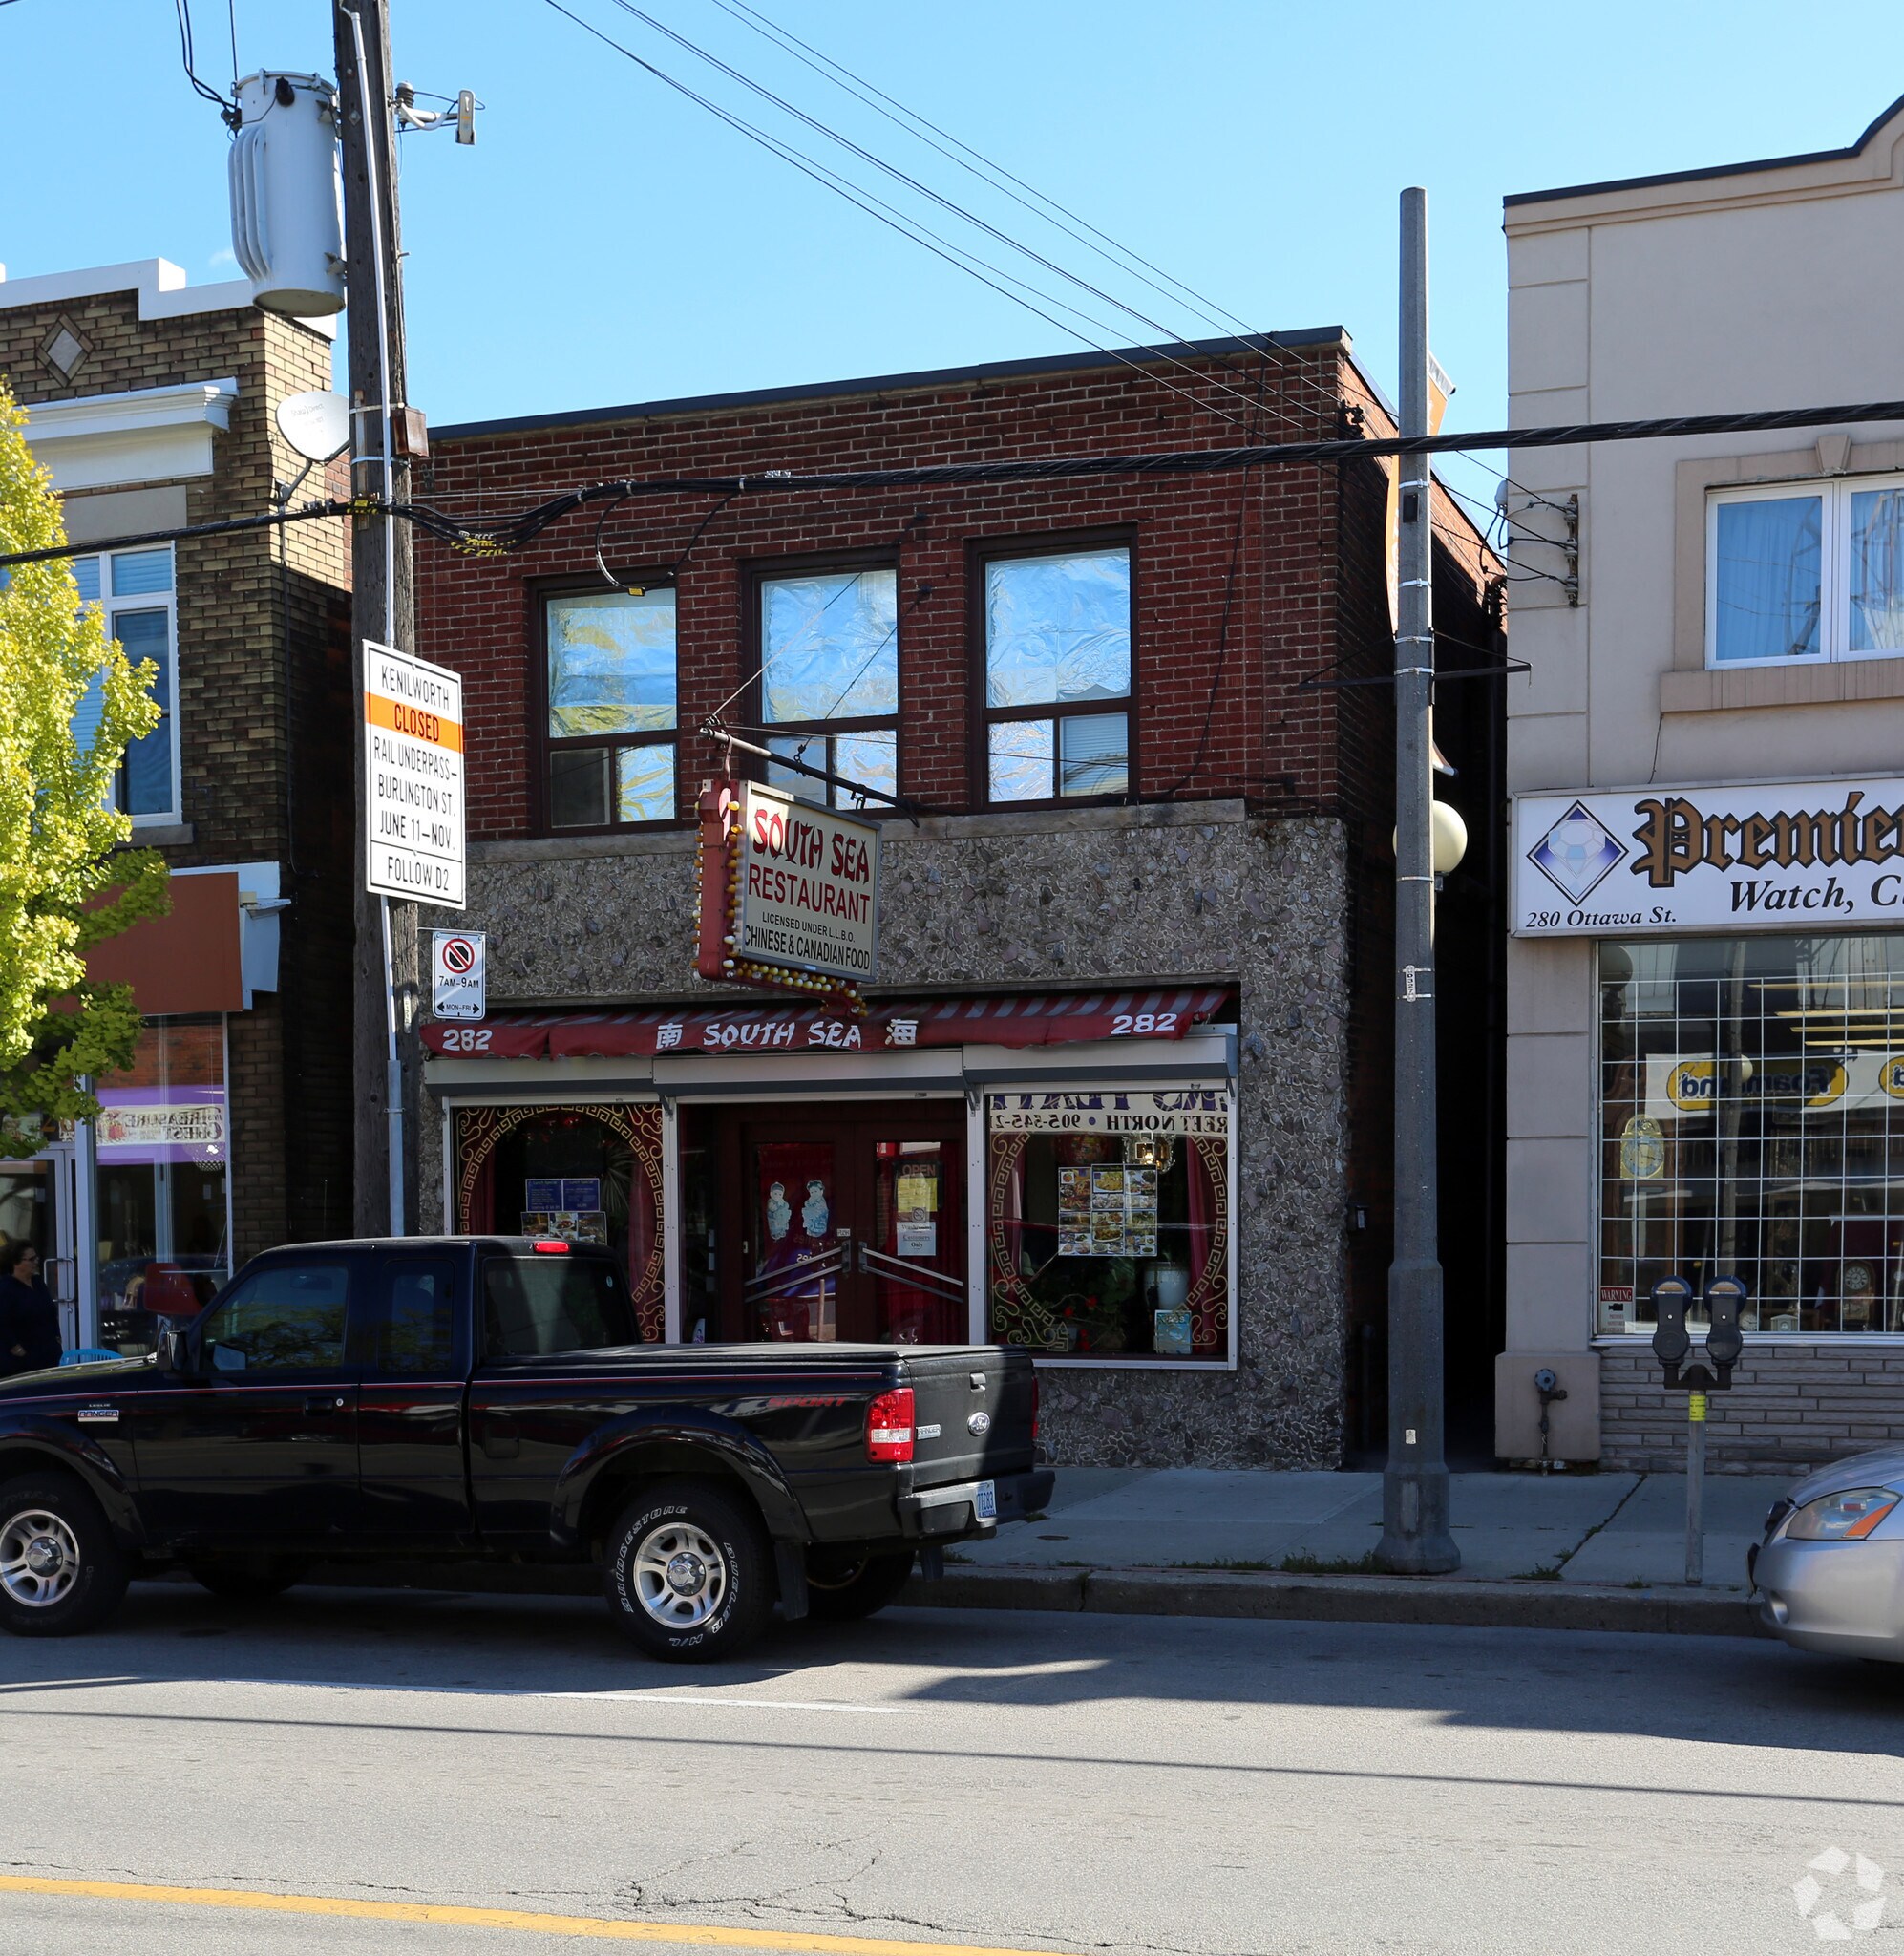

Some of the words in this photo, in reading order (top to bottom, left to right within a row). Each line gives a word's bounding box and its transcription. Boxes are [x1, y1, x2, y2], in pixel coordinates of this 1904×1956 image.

[381, 664, 450, 712] KENILWORTH
[393, 703, 440, 743] CLOSED
[374, 735, 396, 765] RAIL
[378, 773, 439, 813] BURLINGTON
[442, 791, 456, 817] ST.
[380, 810, 407, 839] JUNE
[752, 808, 824, 871] SOUTH
[831, 830, 870, 885] SEA
[388, 856, 433, 887] FOLLOW
[435, 866, 450, 892] D2
[748, 862, 871, 924] RESTAURANT
[1730, 876, 1855, 914] Watch,
[1870, 874, 1904, 907] C
[762, 911, 801, 930] LICENSED
[801, 921, 828, 937] UNDER
[1526, 910, 1560, 928] 280
[1566, 908, 1642, 927] Ottawa
[1648, 905, 1678, 925] St.
[745, 924, 787, 953] CHINESE
[788, 935, 795, 955] &
[796, 935, 844, 966] CANADIAN
[846, 946, 870, 970] FOOD
[442, 1029, 493, 1051] 282
[656, 1022, 684, 1050] 南
[703, 1021, 795, 1048] SOUTH
[806, 1020, 861, 1049] SEA
[884, 1018, 919, 1046] 海
[1109, 1013, 1178, 1036] 282
[902, 1164, 936, 1178] OPEN
[1601, 1289, 1632, 1301] WARNING
[918, 1425, 941, 1435] RANGER
